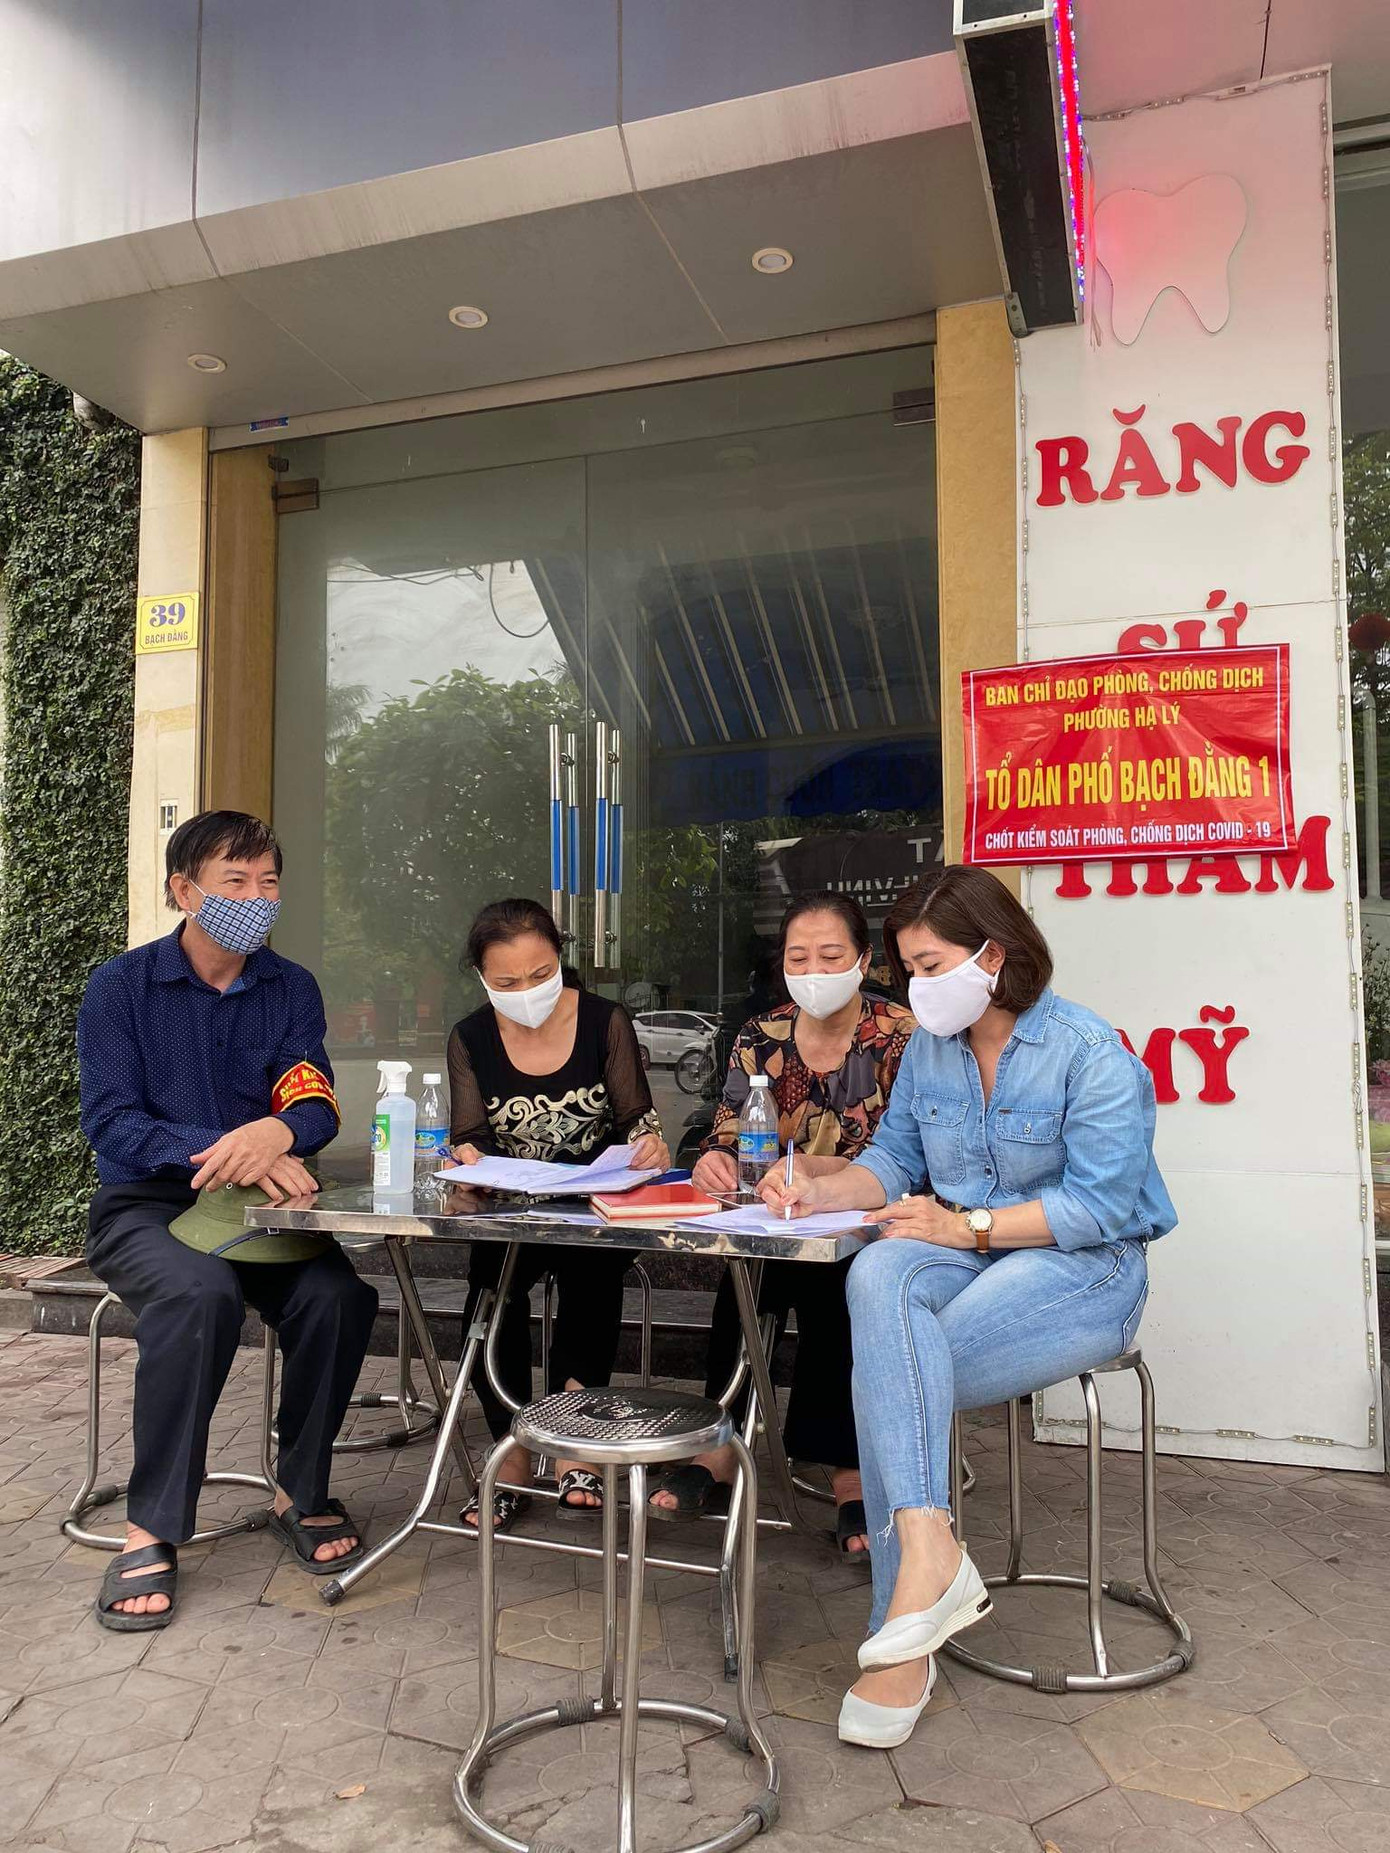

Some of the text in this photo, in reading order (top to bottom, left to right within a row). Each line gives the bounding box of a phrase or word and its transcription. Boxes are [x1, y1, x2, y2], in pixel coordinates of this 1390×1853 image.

[1035, 404, 1310, 507] RĂNG
[149, 602, 186, 627] 39
[985, 663, 1264, 706] BAN CHỈ ĐẠO PHÒNG, CHỐNG DỊCH
[1063, 701, 1181, 733] PHƯỜNG HẠ LÝ
[986, 740, 1271, 811] TỔ DÂN PHỐ BẠCH ĐẰNG 1
[985, 827, 1015, 849] CHỐT
[1017, 824, 1047, 848] KIỂM
[1050, 825, 1080, 848] SOÁT
[1083, 823, 1128, 846] PHÒNG,
[1130, 818, 1173, 844] CHỐNG
[1176, 823, 1204, 846] DỊCH
[1208, 821, 1244, 840] COVID
[1256, 821, 1271, 838] 19
